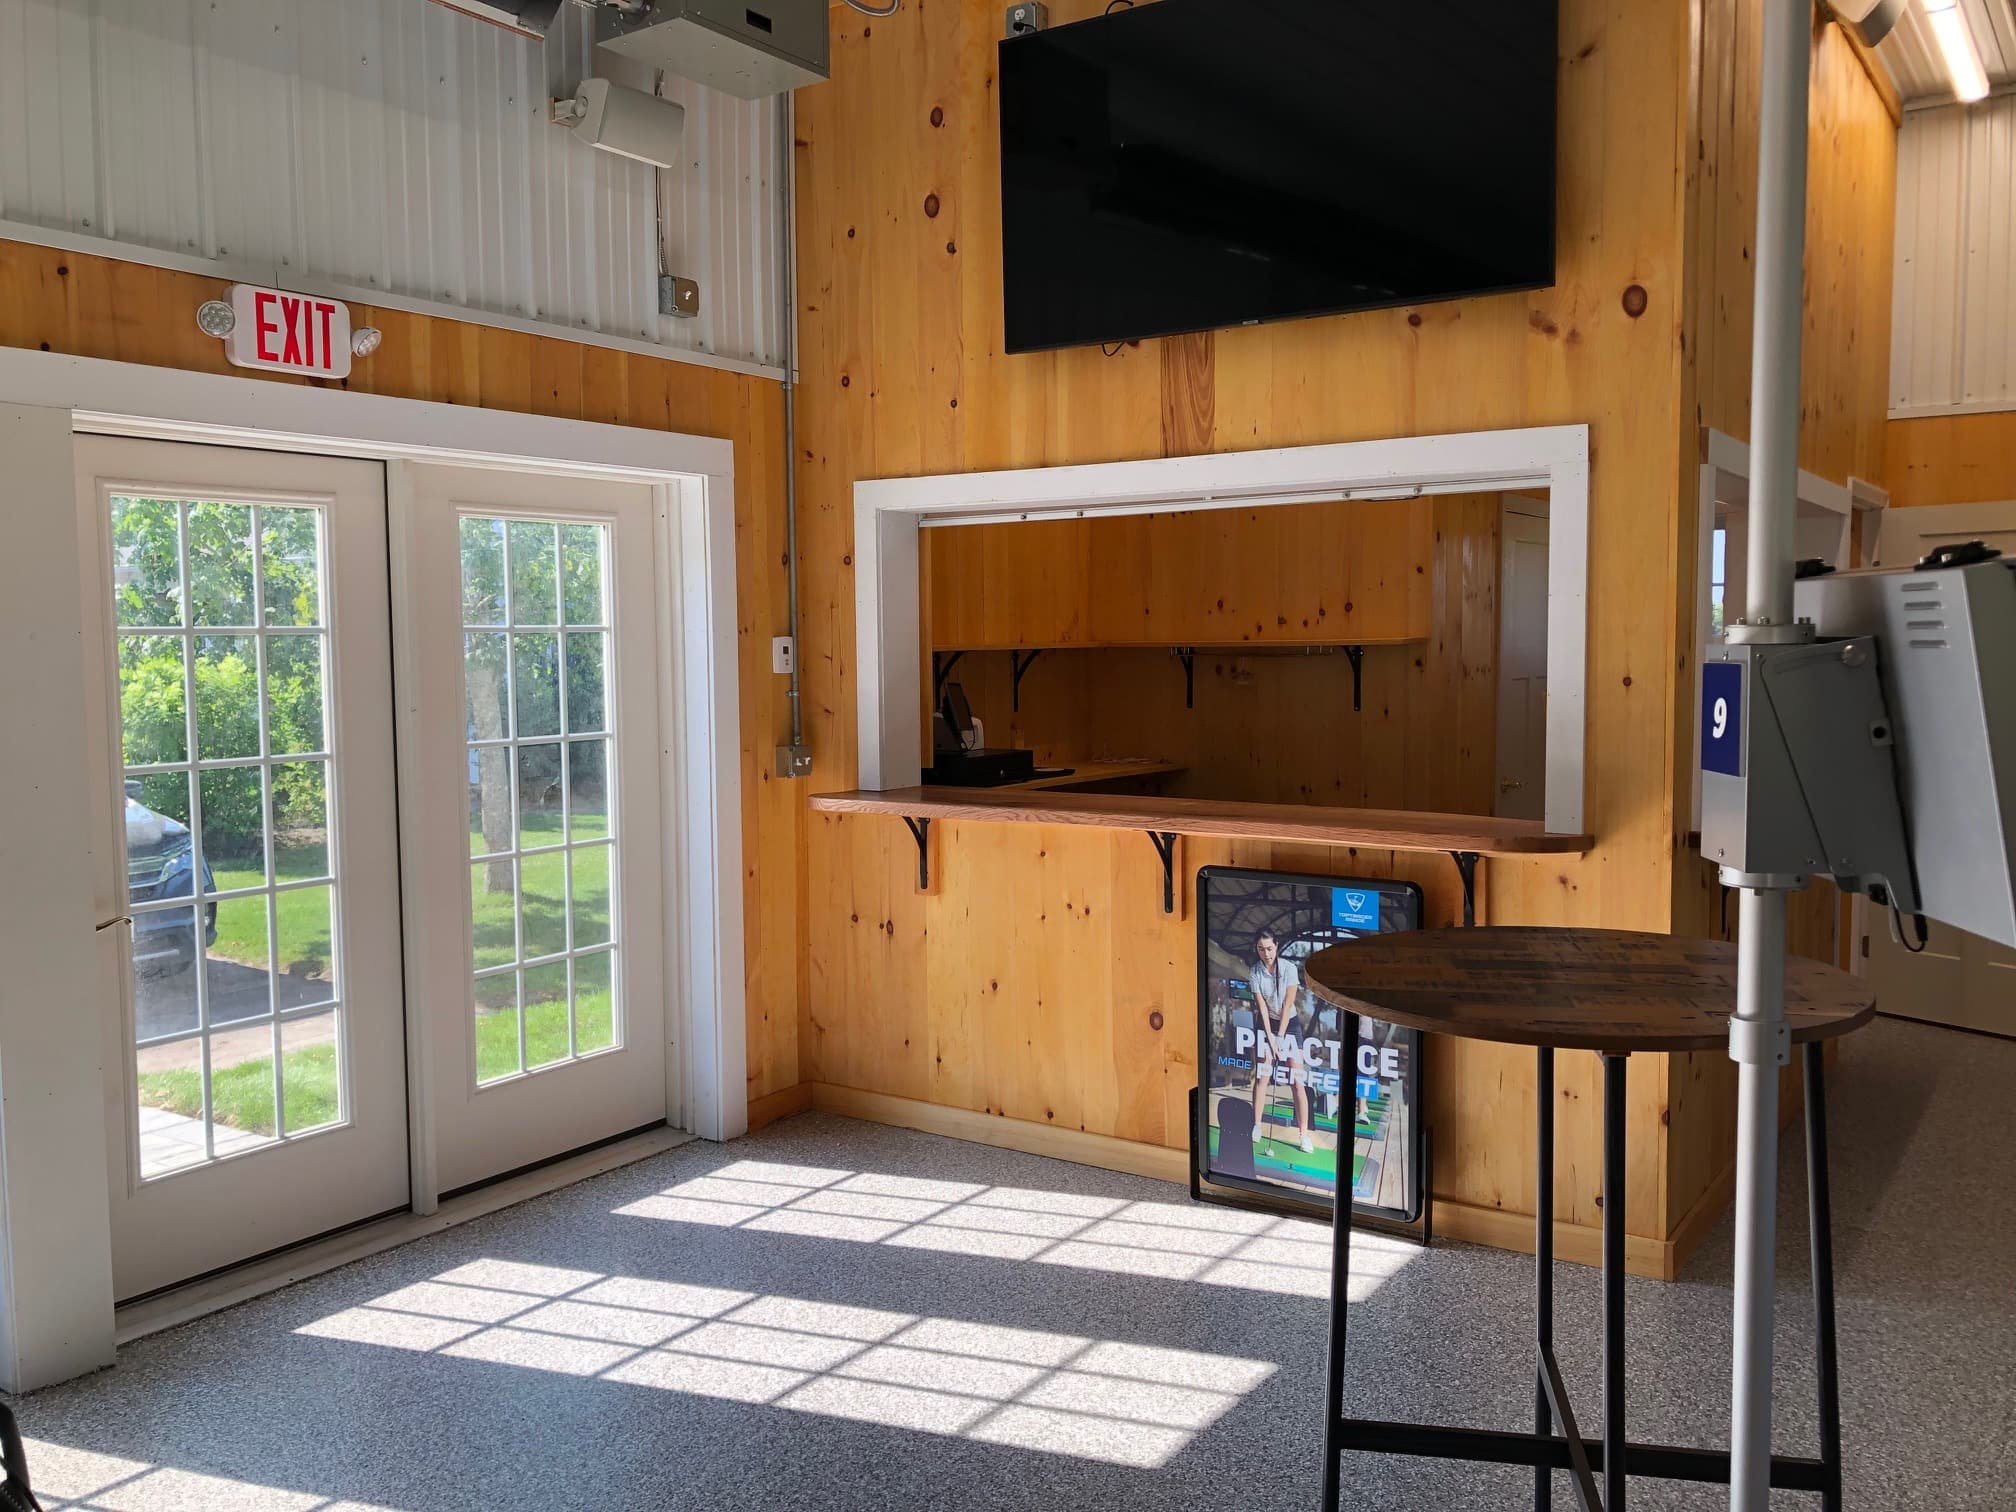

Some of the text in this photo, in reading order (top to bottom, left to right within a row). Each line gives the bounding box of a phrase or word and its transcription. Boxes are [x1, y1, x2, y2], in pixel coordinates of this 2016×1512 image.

[255, 292, 336, 369] EXIT
[1712, 697, 1728, 739] 9
[1217, 1055, 1378, 1097] MADE PERFET
[1235, 1026, 1399, 1080] PRACTCE
